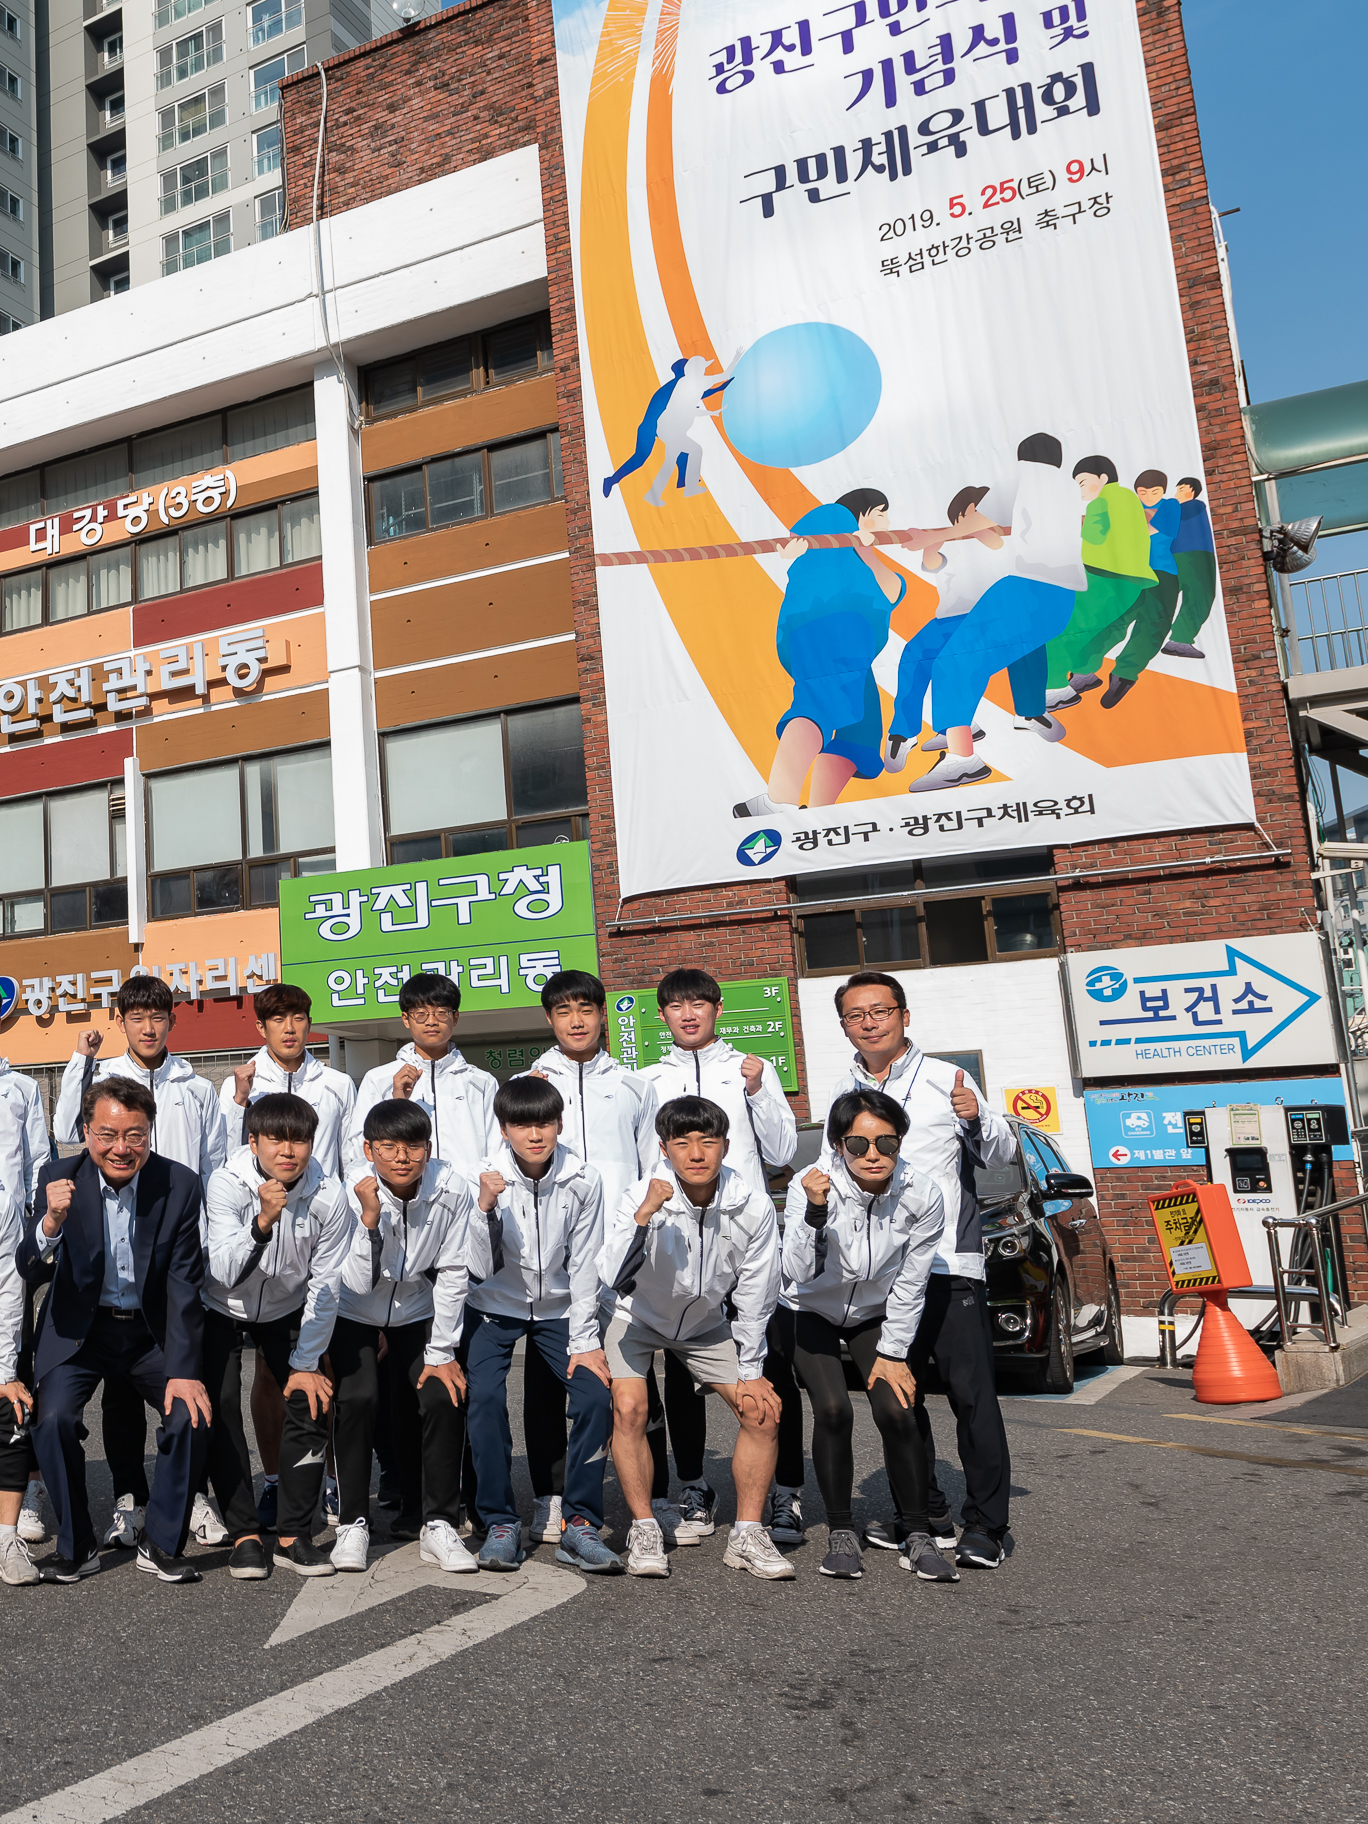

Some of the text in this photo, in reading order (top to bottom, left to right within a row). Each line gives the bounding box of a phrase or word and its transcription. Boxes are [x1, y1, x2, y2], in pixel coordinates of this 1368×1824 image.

[708, 0, 988, 95] 광진구민
[843, 0, 1091, 112] 기념식 및
[739, 61, 1101, 219] 구민체육대회
[878, 153, 1110, 242] 2019. 5. 25(토) 9시
[880, 191, 1114, 278] 뚝섬한강공원 축구장
[303, 863, 565, 942] 광진구청
[763, 986, 780, 998] 3F
[1099, 981, 1274, 1027] 보건소
[719, 1021, 783, 1035] 재무과 건축과 2F
[1135, 1043, 1237, 1060] HEALTH CENTER
[770, 1055, 786, 1067] 1F
[1133, 1149, 1177, 1161] 제1별관
